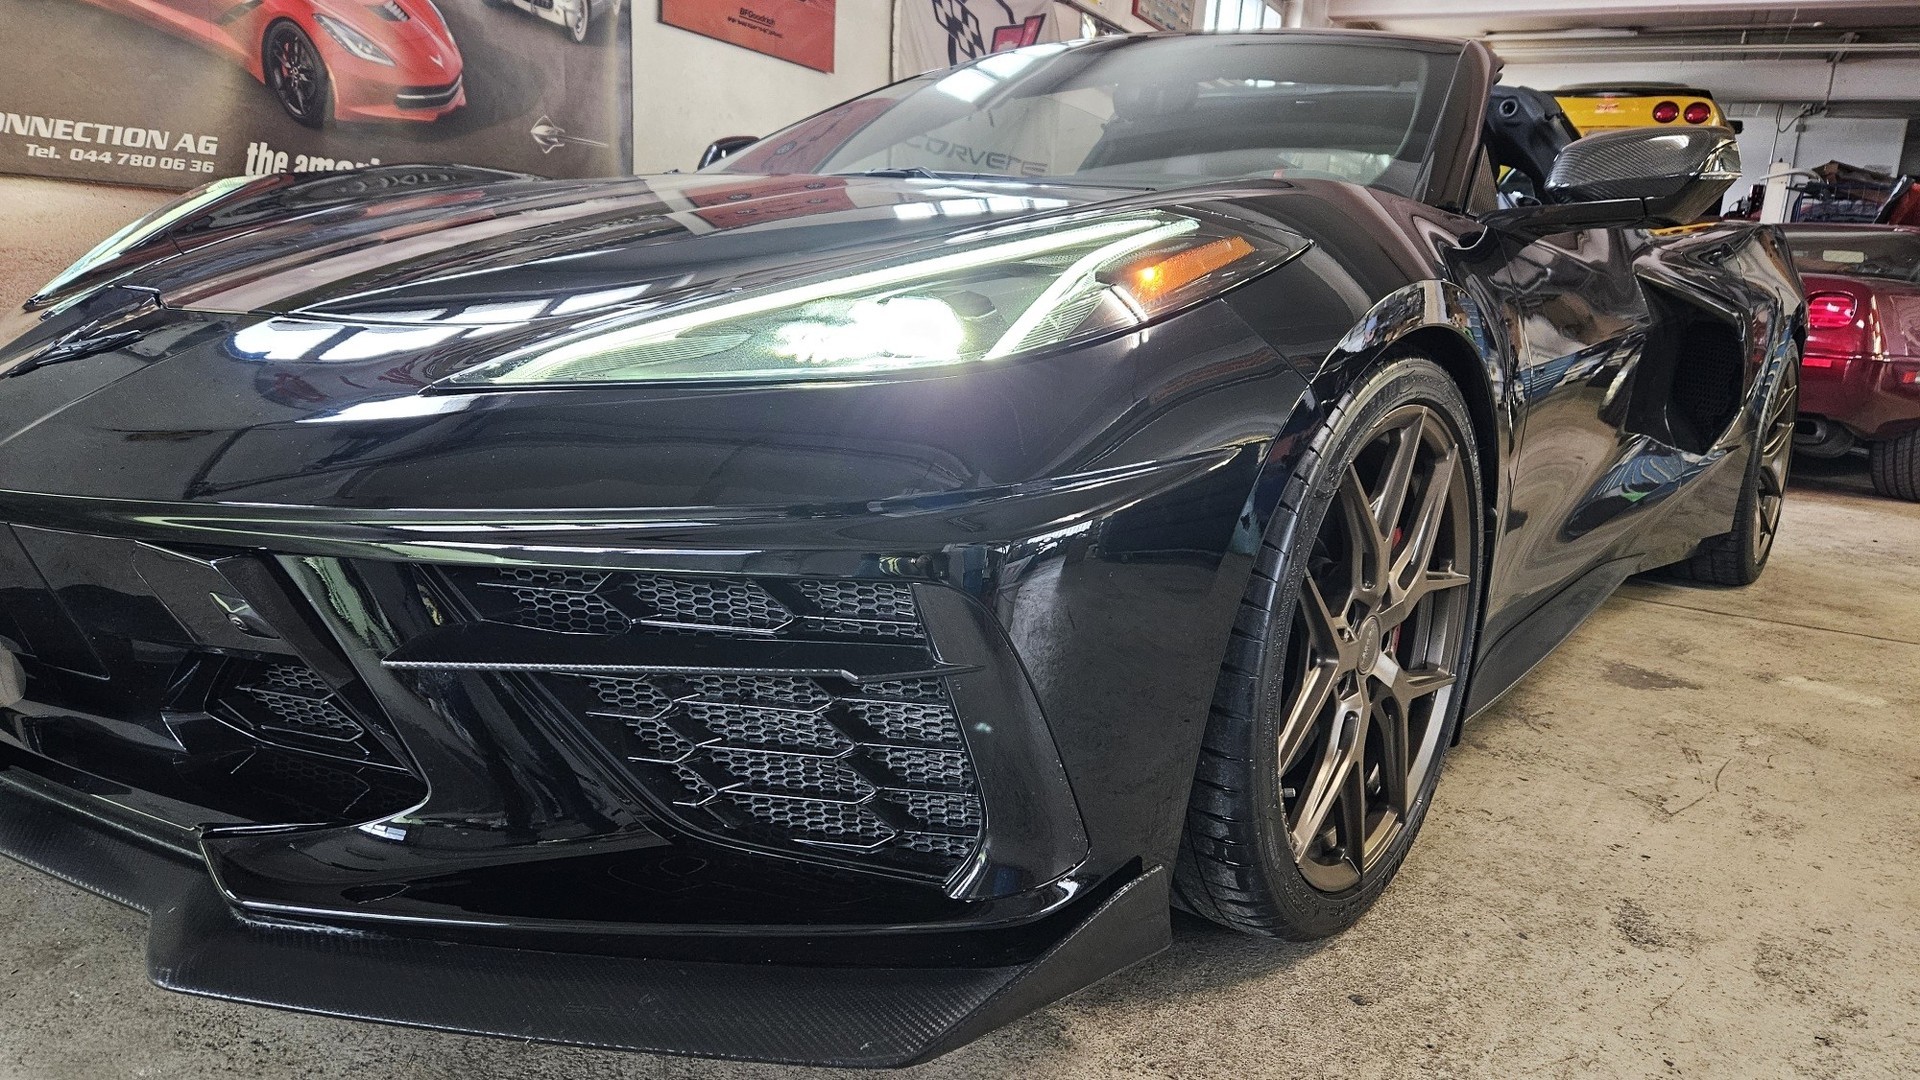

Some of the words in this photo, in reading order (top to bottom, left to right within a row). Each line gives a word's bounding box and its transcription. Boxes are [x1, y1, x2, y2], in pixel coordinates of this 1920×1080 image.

[0, 112, 170, 150] NNECTION
[173, 133, 219, 156] AG
[26, 143, 61, 160] Tel.
[69, 148, 113, 165] 044
[117, 152, 156, 168] 780
[159, 156, 186, 171] 06
[189, 160, 215, 173] 36
[245, 141, 289, 176] the
